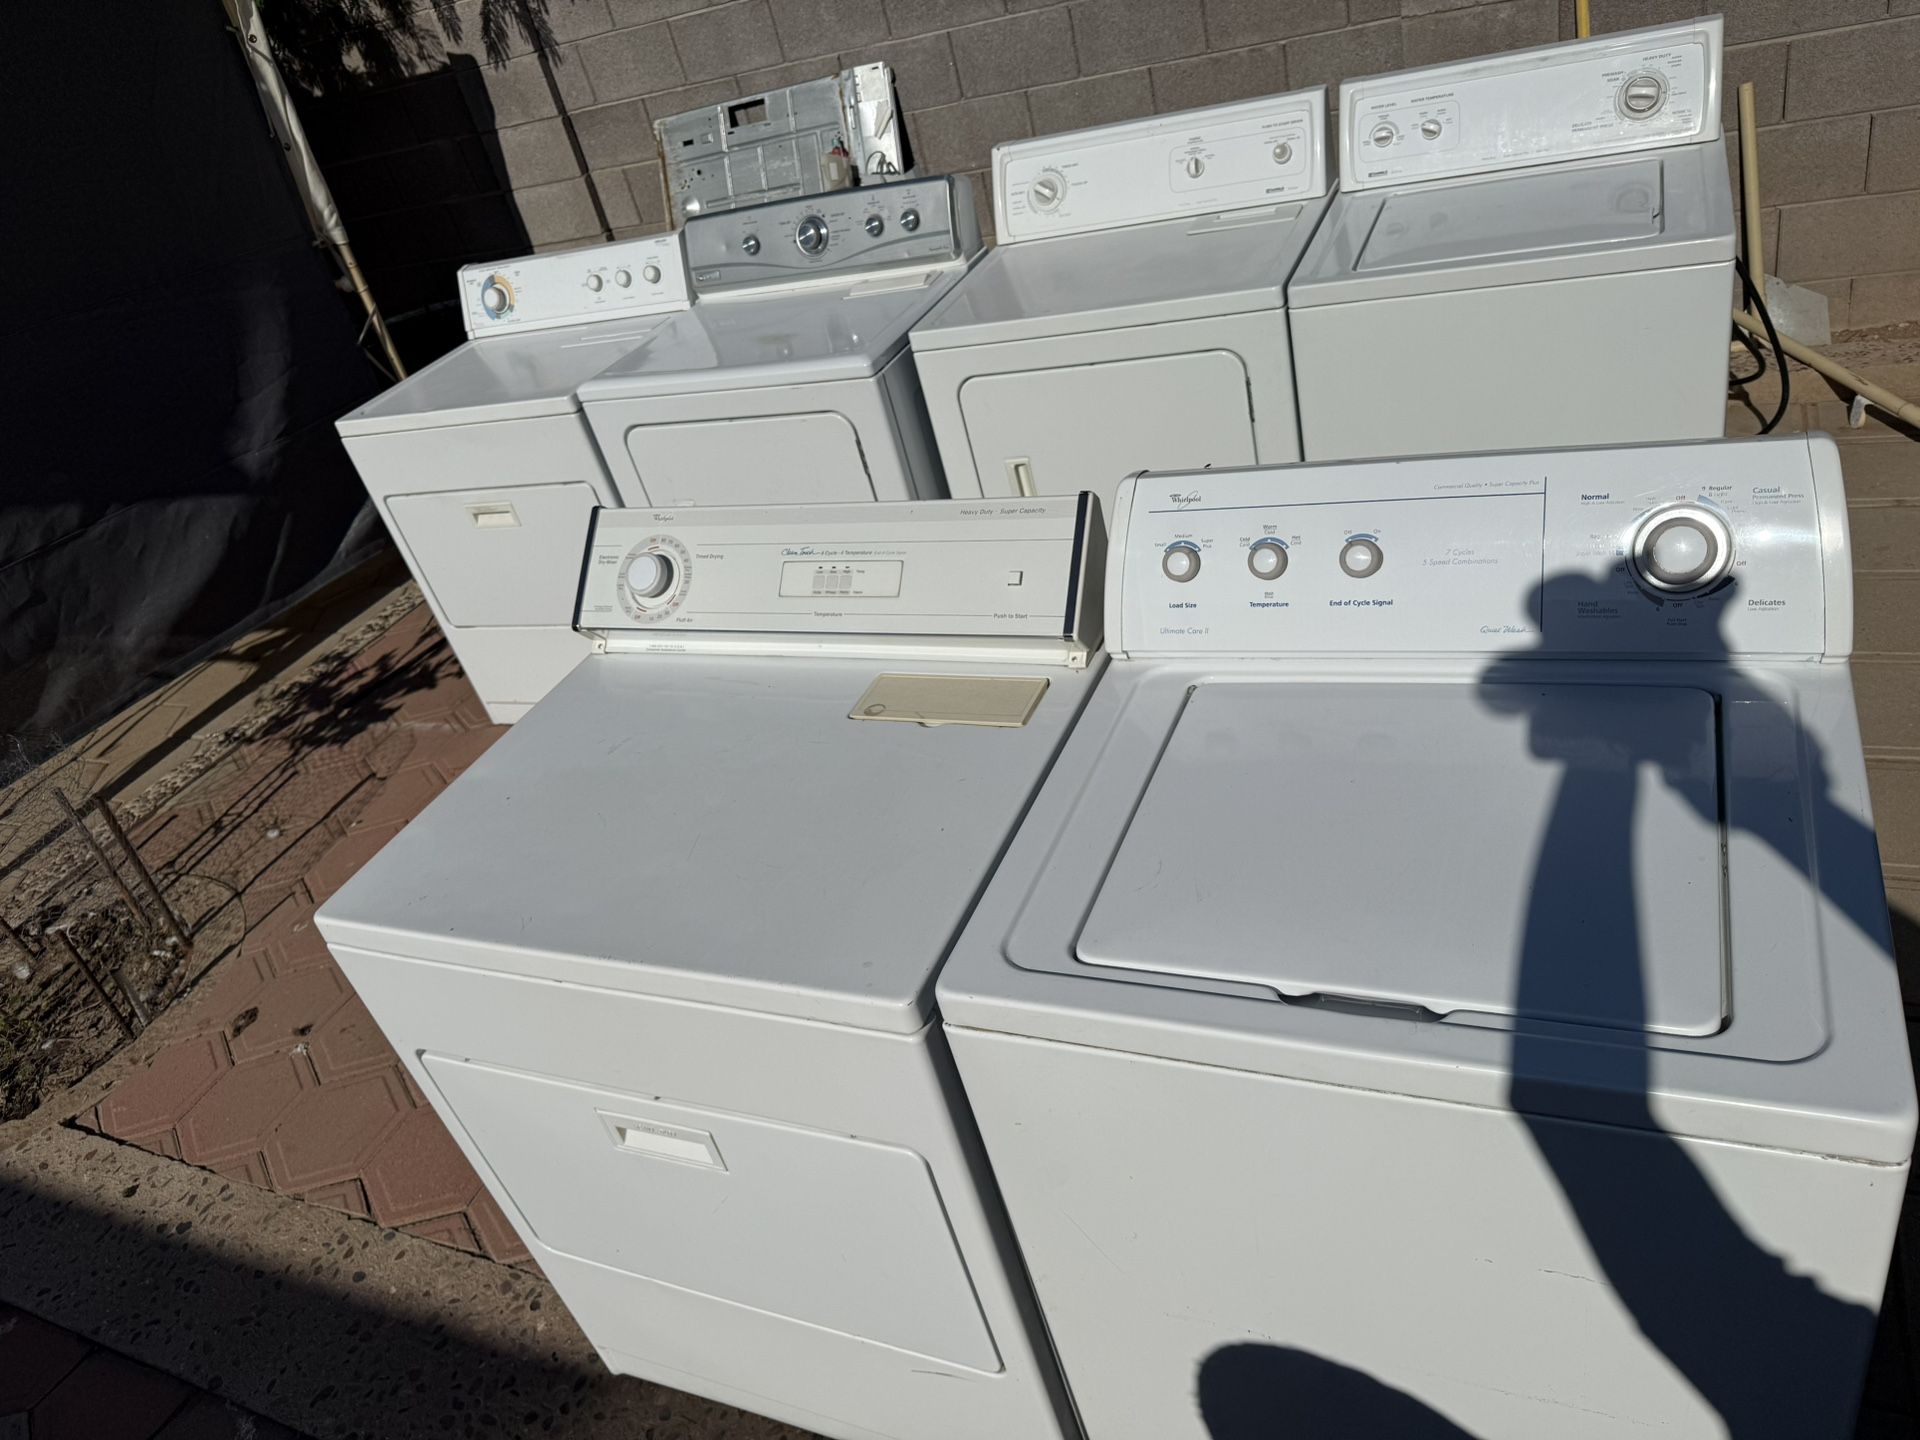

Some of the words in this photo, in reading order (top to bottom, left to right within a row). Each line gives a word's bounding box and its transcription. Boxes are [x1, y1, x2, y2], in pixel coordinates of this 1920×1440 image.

[1752, 486, 1781, 494] Casual
[1580, 492, 1610, 501] Normal
[959, 508, 980, 517] Heavy
[980, 507, 994, 516] Duty
[1000, 506, 1018, 516] Super
[1019, 505, 1047, 515] Capacity
[1249, 601, 1290, 609] Temperature
[1329, 599, 1343, 607] End
[1343, 599, 1352, 607] of
[1352, 599, 1371, 608] Cycle
[1371, 598, 1394, 607] Signal
[1748, 599, 1786, 607] Delicates
[1160, 627, 1185, 635] Ultimate
[1186, 626, 1204, 635] Care
